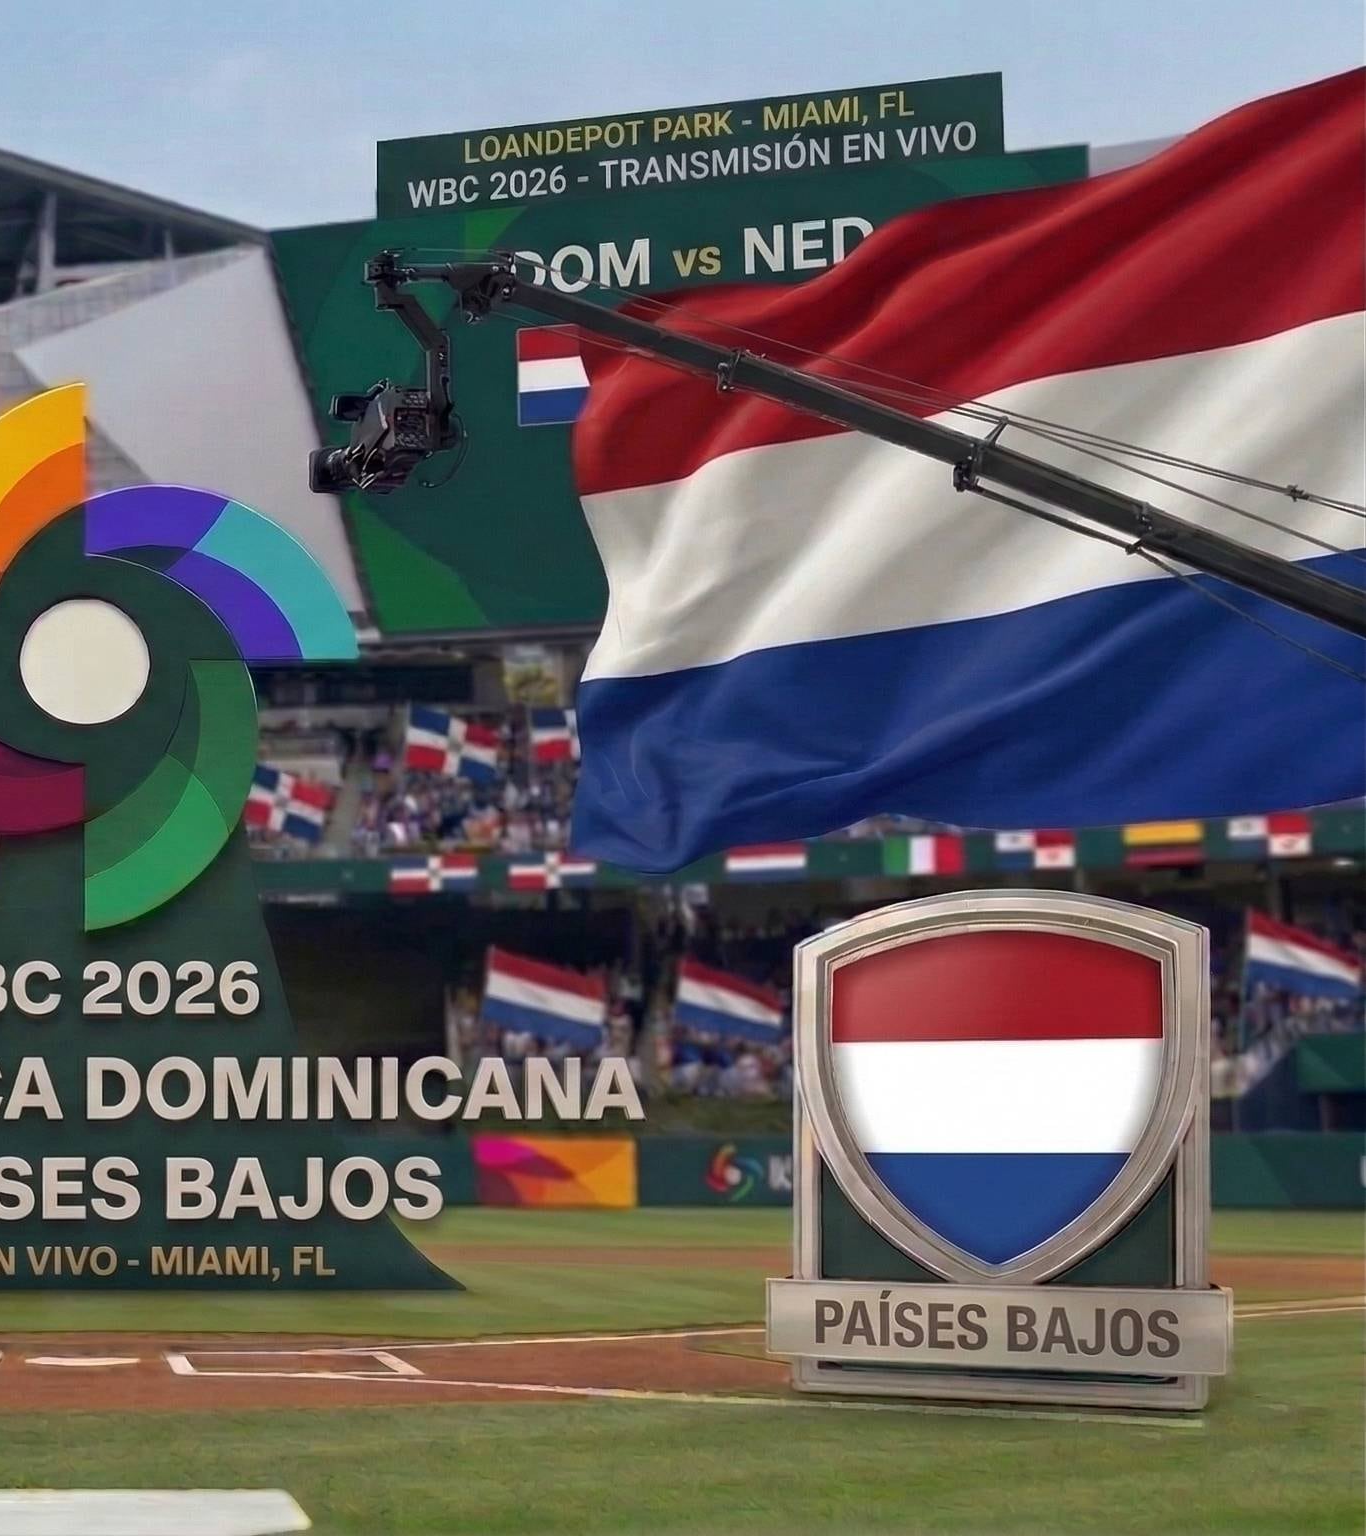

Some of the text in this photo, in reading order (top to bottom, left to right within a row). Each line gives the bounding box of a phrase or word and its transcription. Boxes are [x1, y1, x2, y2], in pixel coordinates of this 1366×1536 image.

[464, 119, 645, 164] LOANDEPOT
[653, 109, 733, 144] PARK
[762, 95, 869, 131] MIAMI,
[879, 90, 915, 119] FL
[407, 174, 480, 209] WBC
[489, 165, 567, 200] 2026
[599, 132, 831, 190] TRANSMISIÓN
[843, 131, 886, 164] EN
[896, 120, 977, 157] VIVO
[82, 960, 261, 1016] 2026
[86, 1056, 646, 1121] DOMINICANA
[166, 1156, 444, 1221] BAJOS
[27, 1246, 118, 1276] VIVO
[151, 1246, 281, 1282] MIAMI,
[293, 1246, 336, 1276] FL
[814, 1290, 1181, 1358] PAÍSES BAJOS
